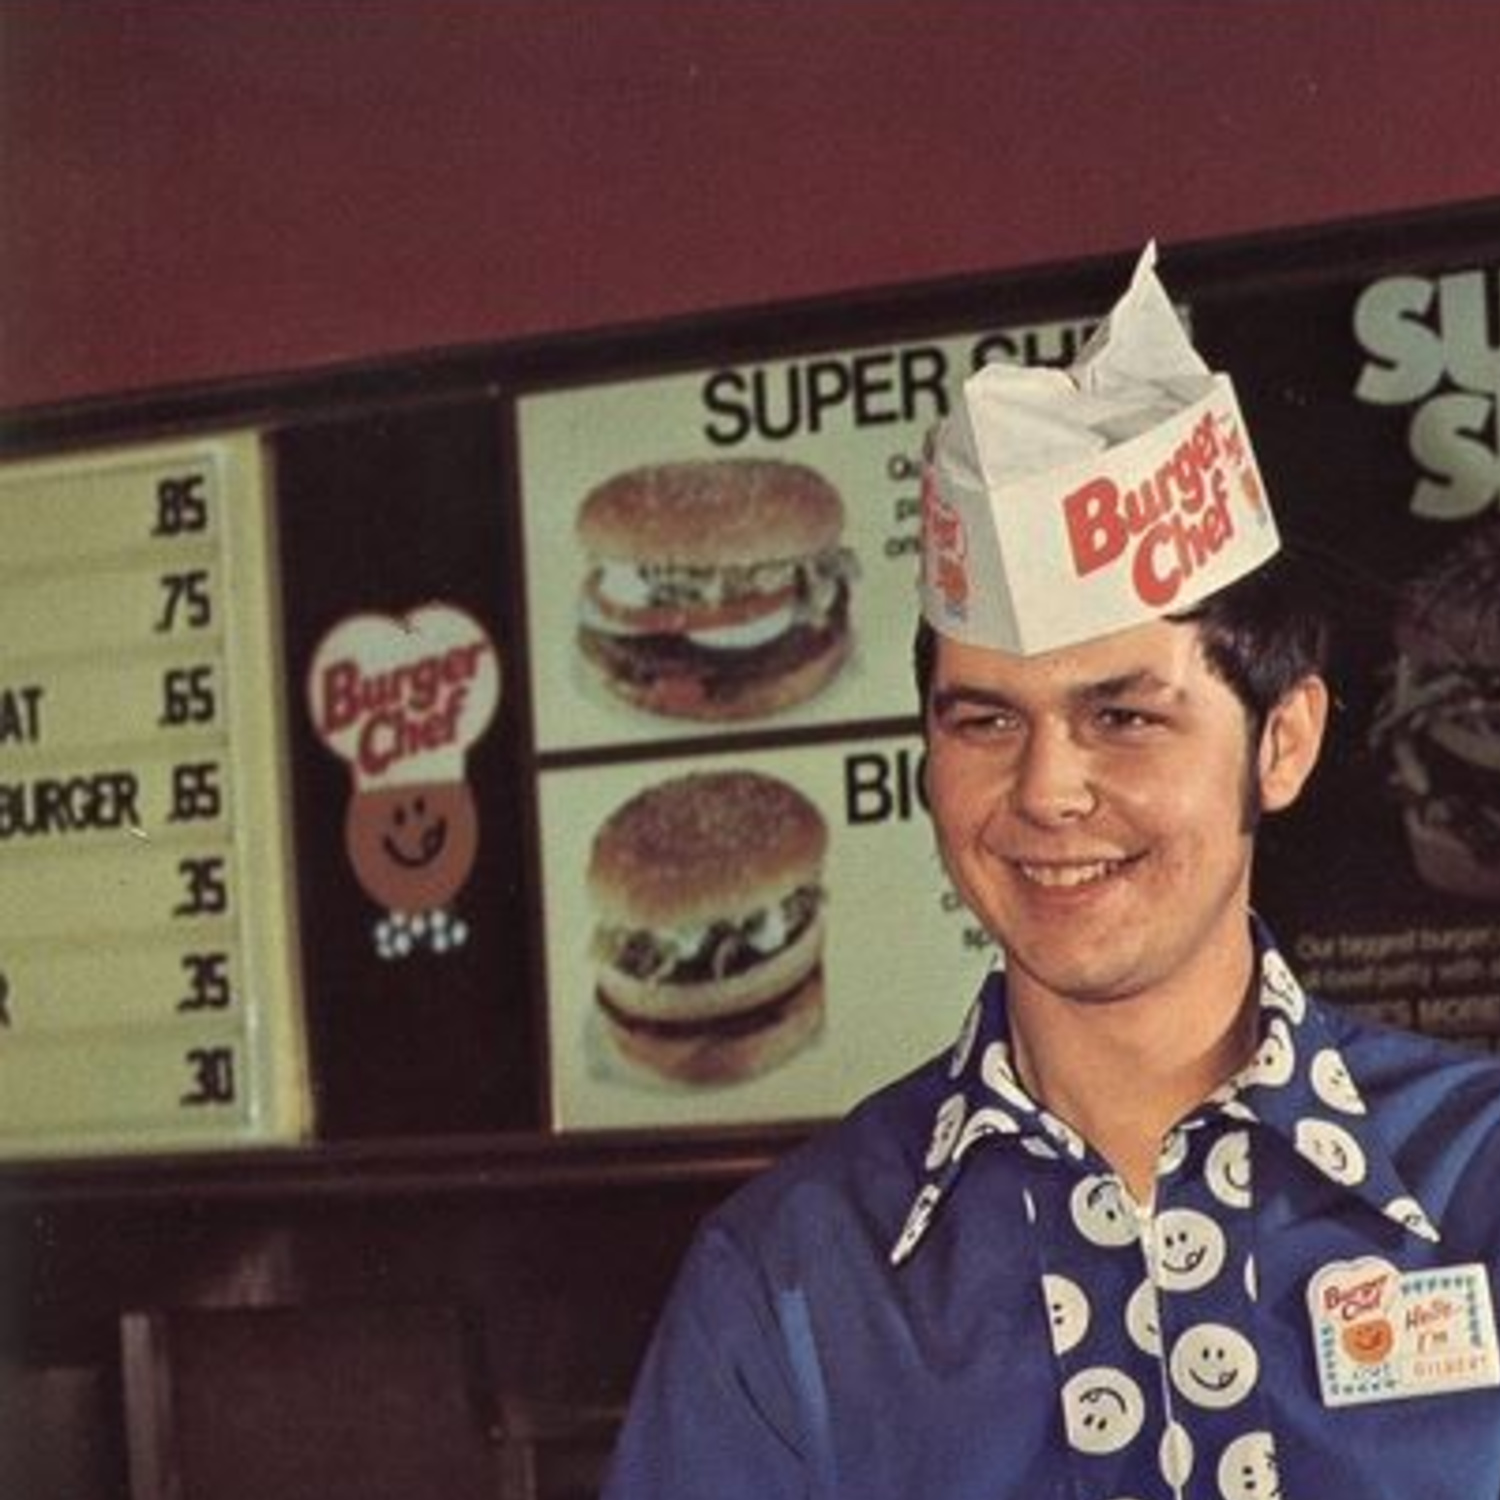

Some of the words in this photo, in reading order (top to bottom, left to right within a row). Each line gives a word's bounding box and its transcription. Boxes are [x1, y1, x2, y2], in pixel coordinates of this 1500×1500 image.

[703, 345, 950, 446] SUPER
[1063, 410, 1219, 579] Burger
[1131, 468, 1234, 608] Chef
[152, 569, 211, 634] .75
[157, 666, 215, 728] .65
[323, 640, 487, 735] Burger
[358, 685, 468, 776] Chef
[168, 761, 221, 823] .65
[172, 857, 227, 918] .35
[175, 953, 230, 1014] .35
[179, 1047, 236, 1107] .30
